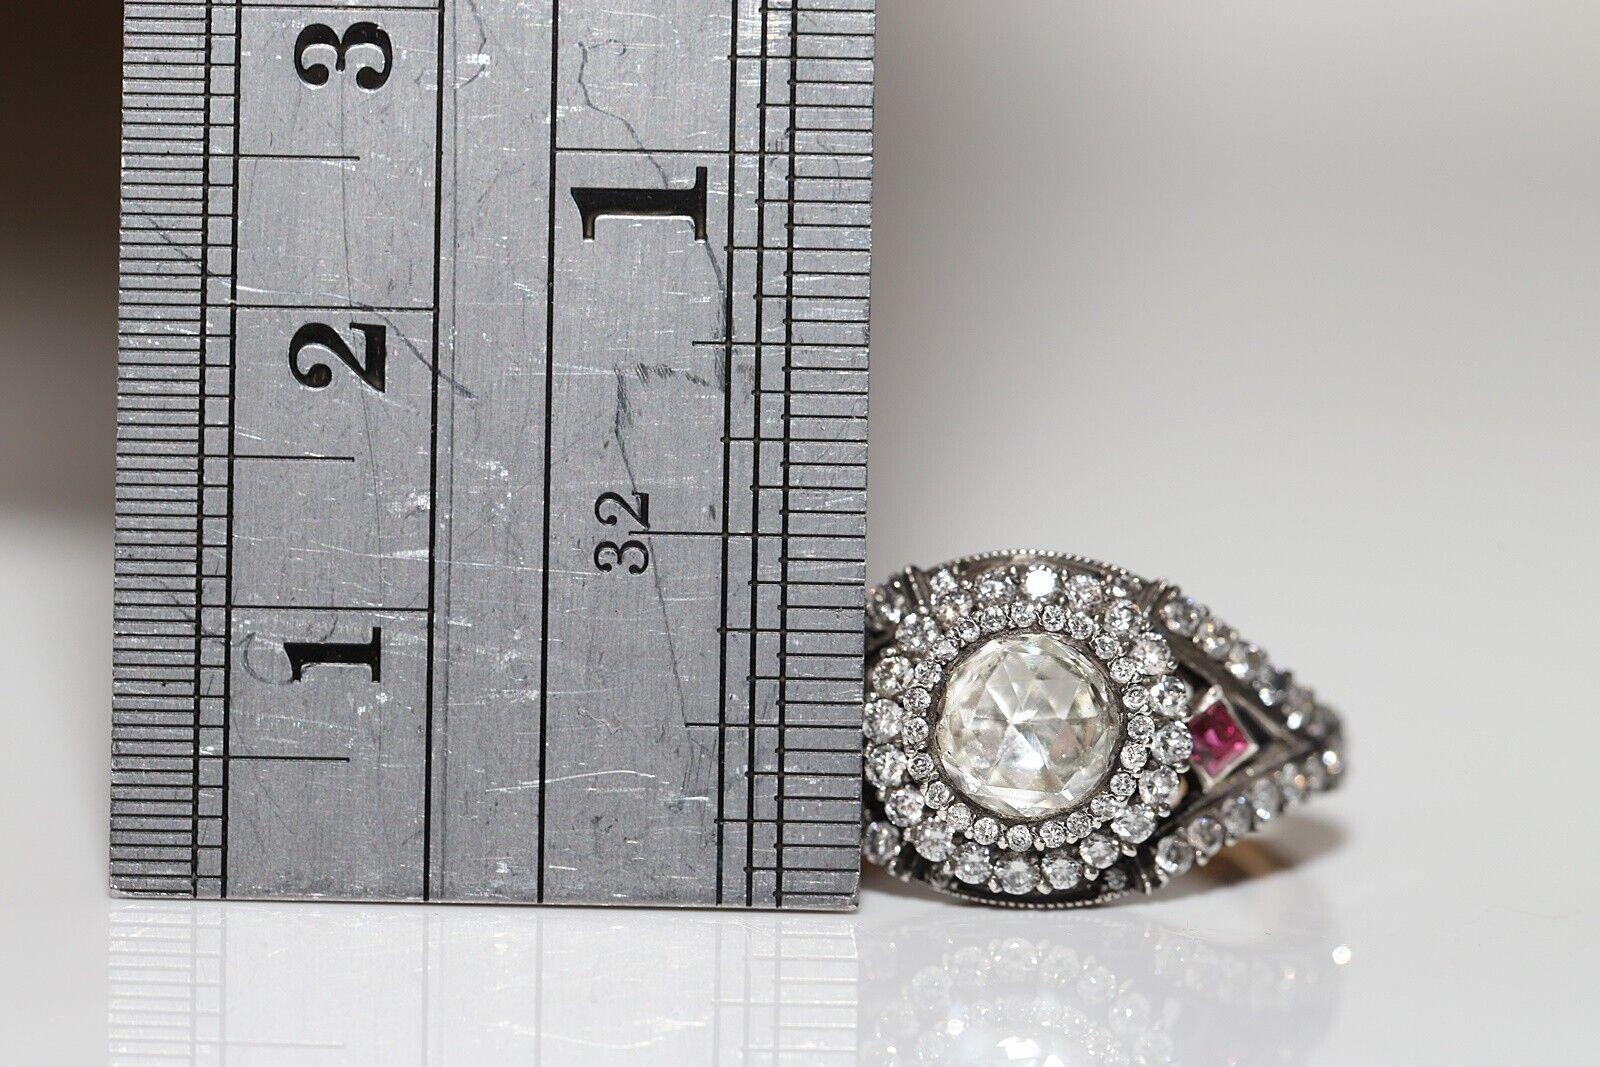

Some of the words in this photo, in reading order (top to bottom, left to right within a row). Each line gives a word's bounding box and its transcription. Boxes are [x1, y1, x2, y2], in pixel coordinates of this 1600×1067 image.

[294, 22, 393, 89] 3
[570, 166, 709, 243] 1
[289, 321, 387, 393] 2
[594, 490, 650, 575] 32
[284, 627, 382, 683] 1
